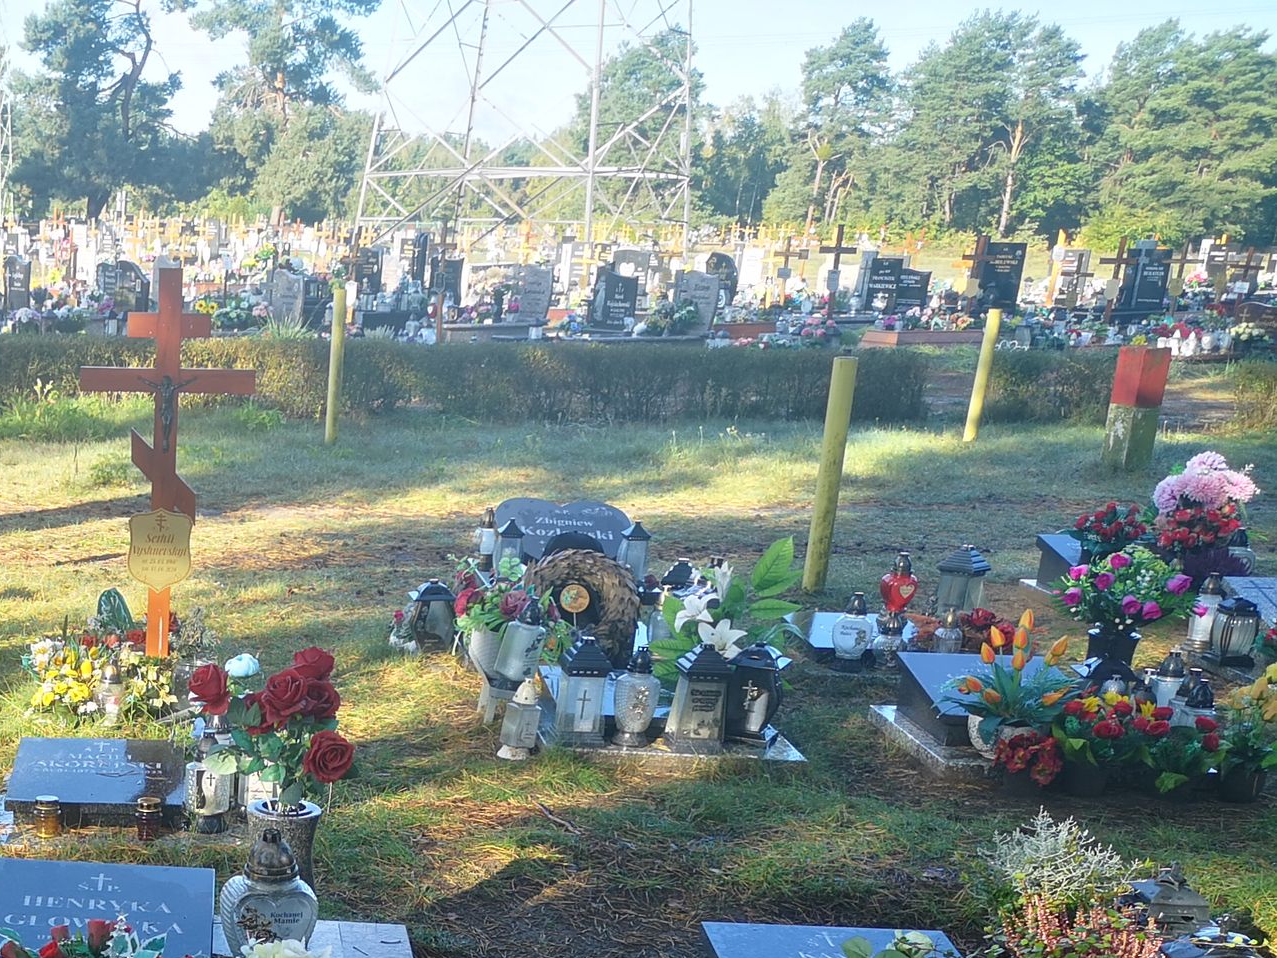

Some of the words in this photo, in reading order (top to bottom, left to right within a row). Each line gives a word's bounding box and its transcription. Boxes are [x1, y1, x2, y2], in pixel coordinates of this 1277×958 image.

[535, 516, 594, 527] Zbigniew
[23, 895, 172, 915] HENRYKA
[270, 911, 303, 919] Kochanej
